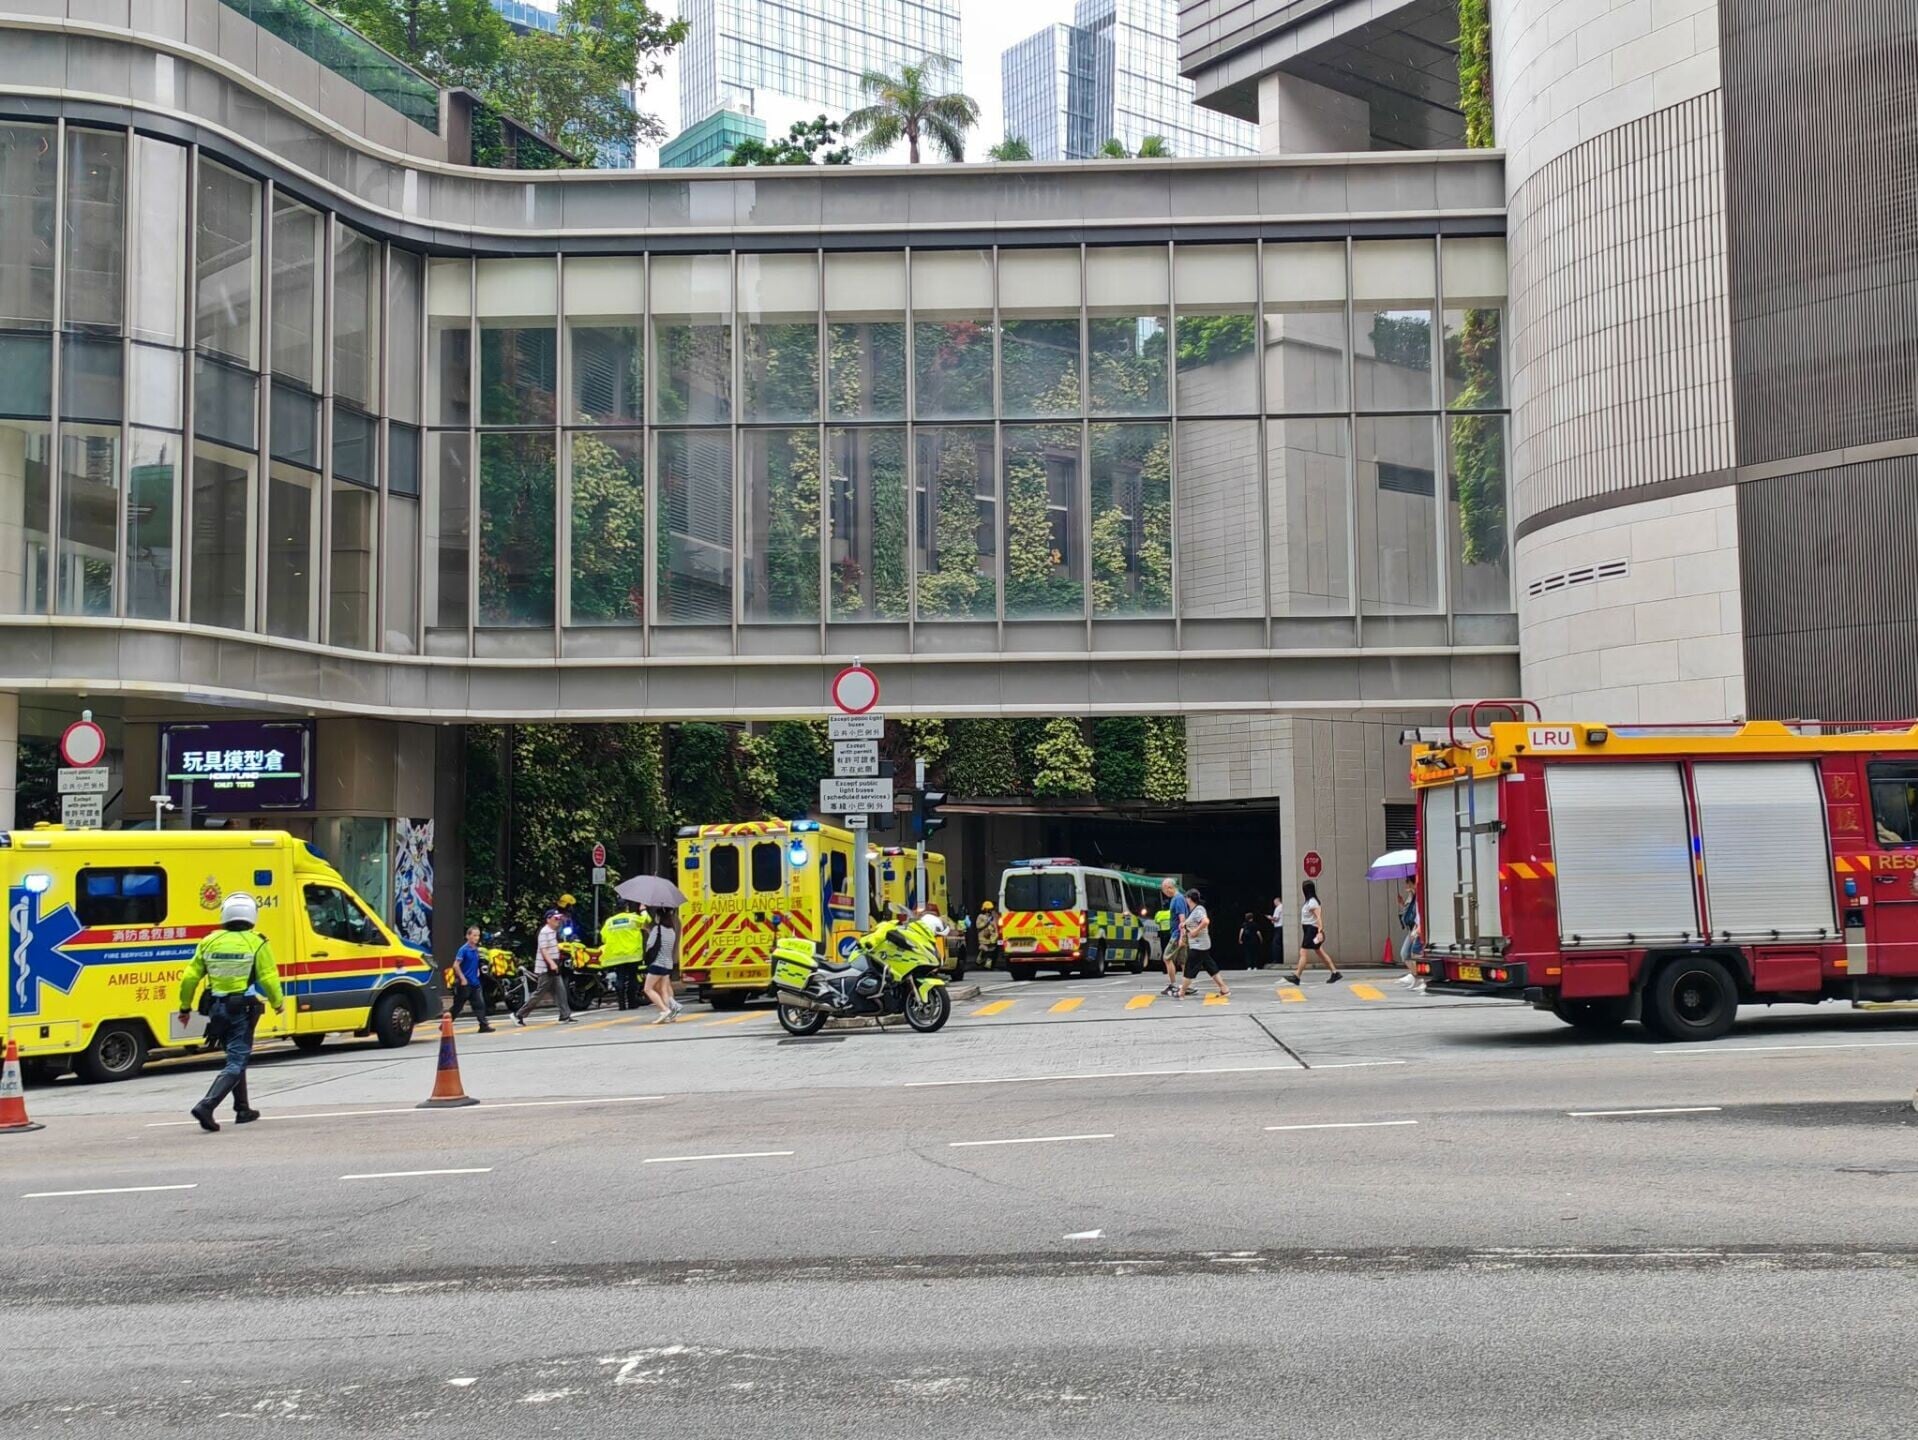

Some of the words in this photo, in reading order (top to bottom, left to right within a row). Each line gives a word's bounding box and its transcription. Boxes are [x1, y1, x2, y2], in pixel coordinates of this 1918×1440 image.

[1533, 731, 1570, 745] LRU
[182, 749, 285, 772] 玩具模型倉
[710, 897, 785, 913] AMBULANCE
[711, 935, 740, 947] KEEP
[103, 951, 120, 959] FIRE
[120, 950, 154, 959] SERVICES
